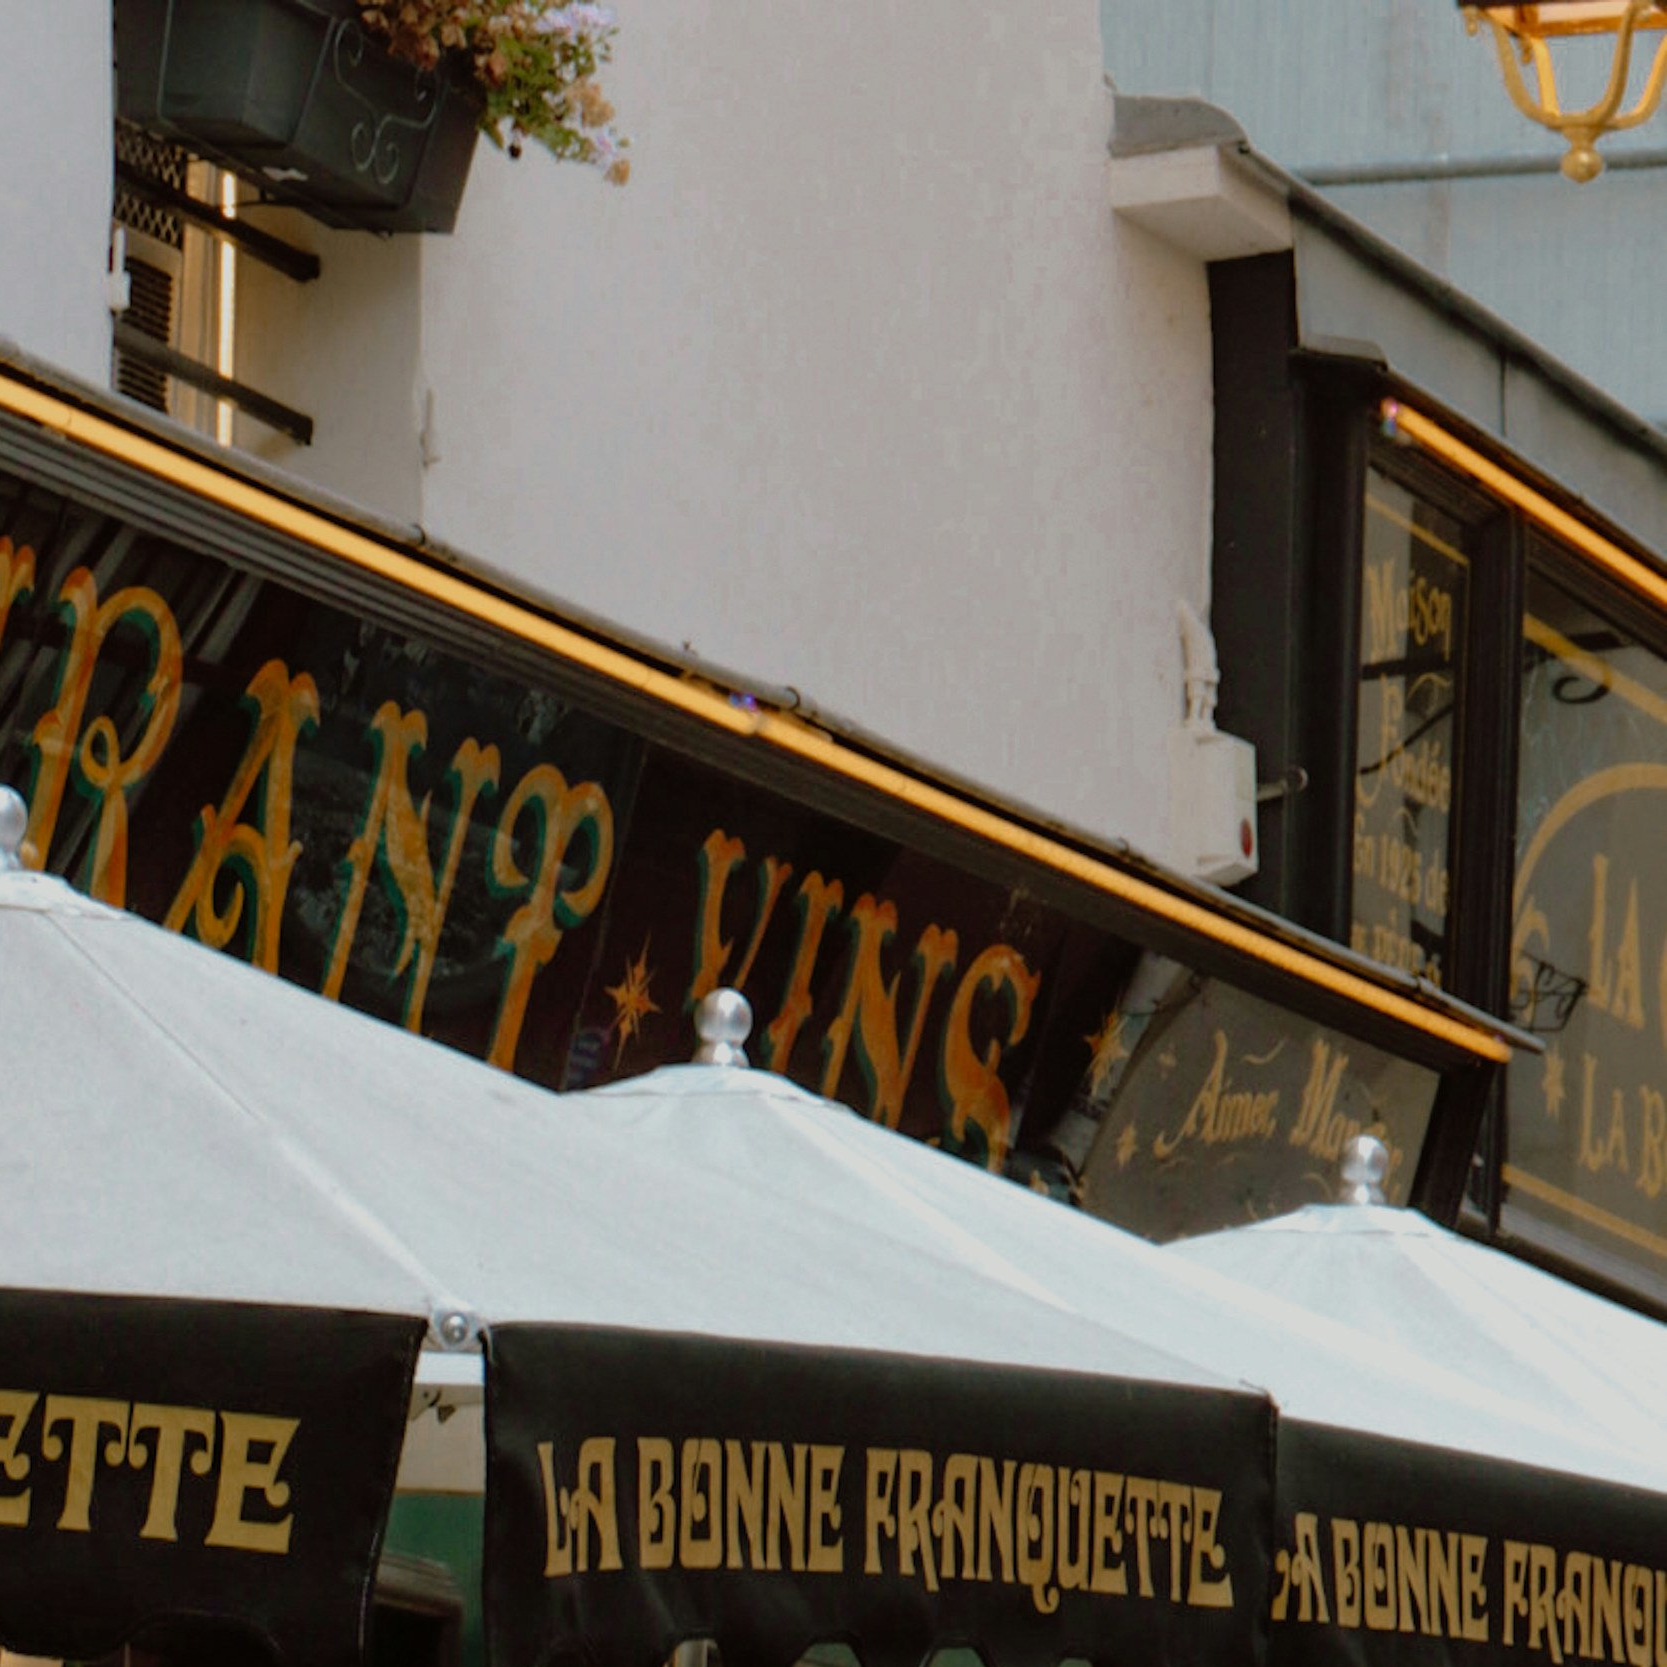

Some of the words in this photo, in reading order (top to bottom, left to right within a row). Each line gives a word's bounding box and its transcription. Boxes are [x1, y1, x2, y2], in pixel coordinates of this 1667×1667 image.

[686, 828, 1041, 1175] VINS
[536, 1436, 623, 1577] LA
[636, 1436, 846, 1573] BONNE
[864, 1446, 1234, 1615] FRANQUETTE
[1330, 1517, 1490, 1643] BONNE
